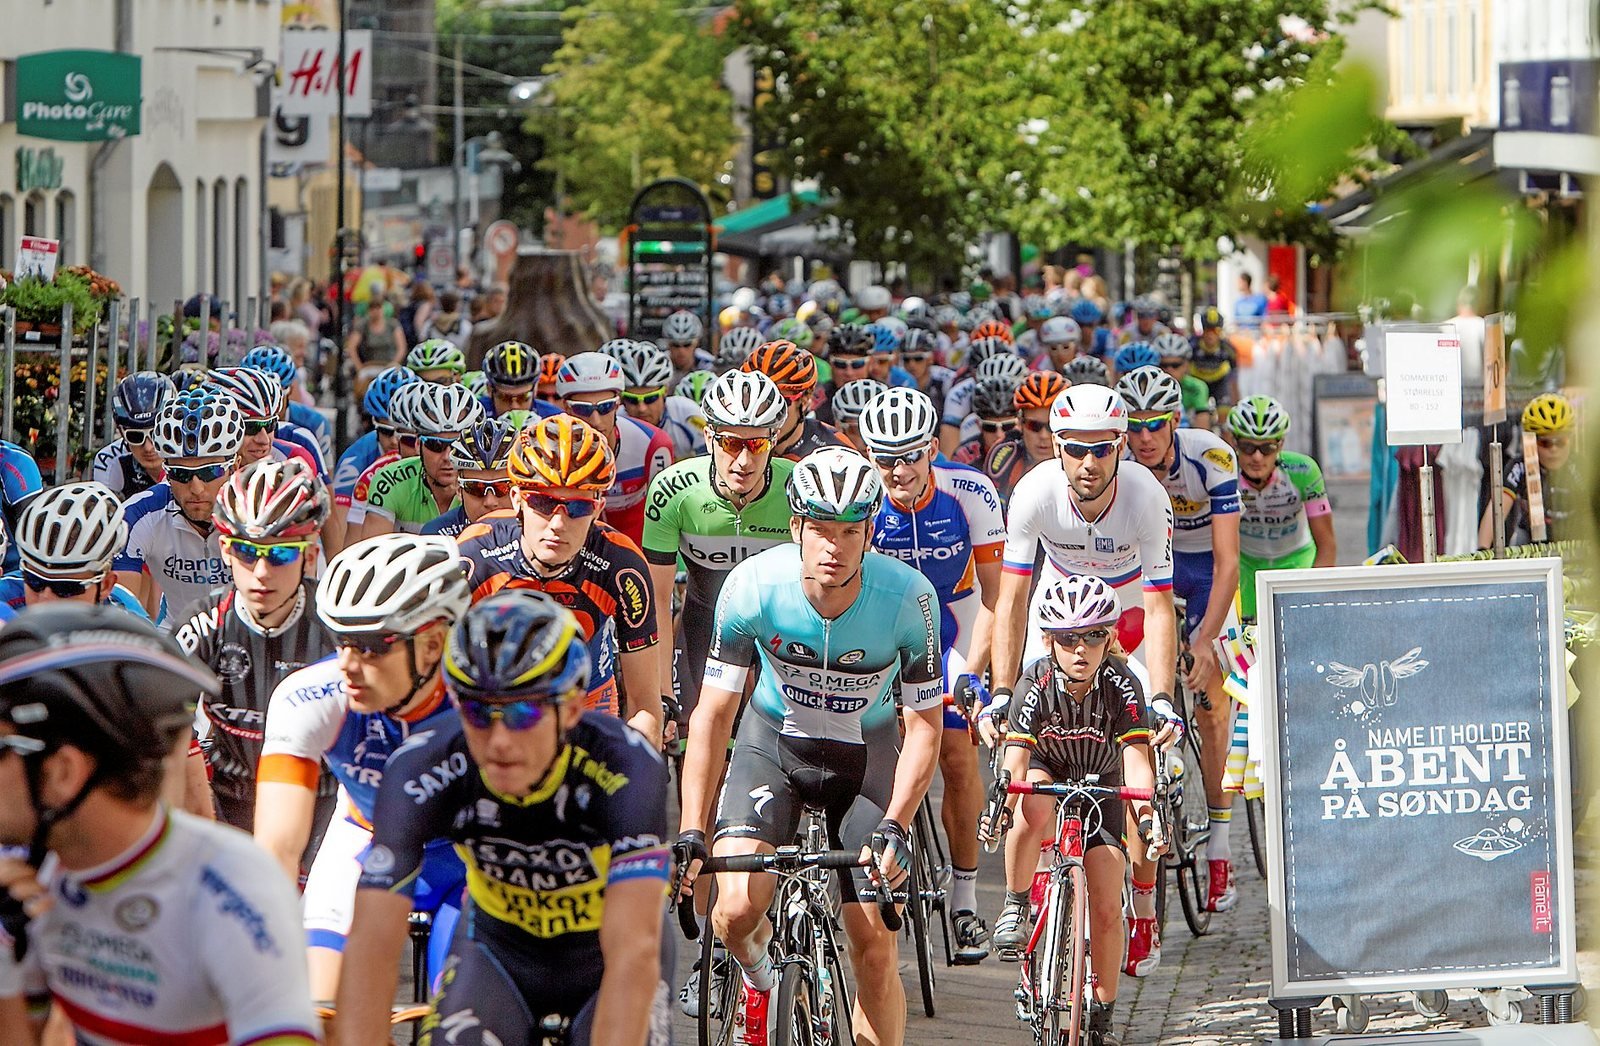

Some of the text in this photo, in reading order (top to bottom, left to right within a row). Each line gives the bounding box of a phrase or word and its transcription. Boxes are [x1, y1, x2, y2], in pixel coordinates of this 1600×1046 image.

[94, 438, 131, 471] IAM
[369, 464, 418, 508] belkin
[645, 470, 700, 522] belkin
[758, 526, 791, 534] GIANT
[809, 672, 880, 687] OMEGA
[786, 685, 864, 711] QUICK STEP
[1368, 721, 1531, 749] NAME IT HOLDER
[404, 751, 468, 805] SAXO
[1320, 738, 1532, 790] ÅBENT
[1320, 785, 1533, 820] PÅ SØNDAG
[480, 844, 581, 870] SAXO
[1534, 877, 1546, 913] name
